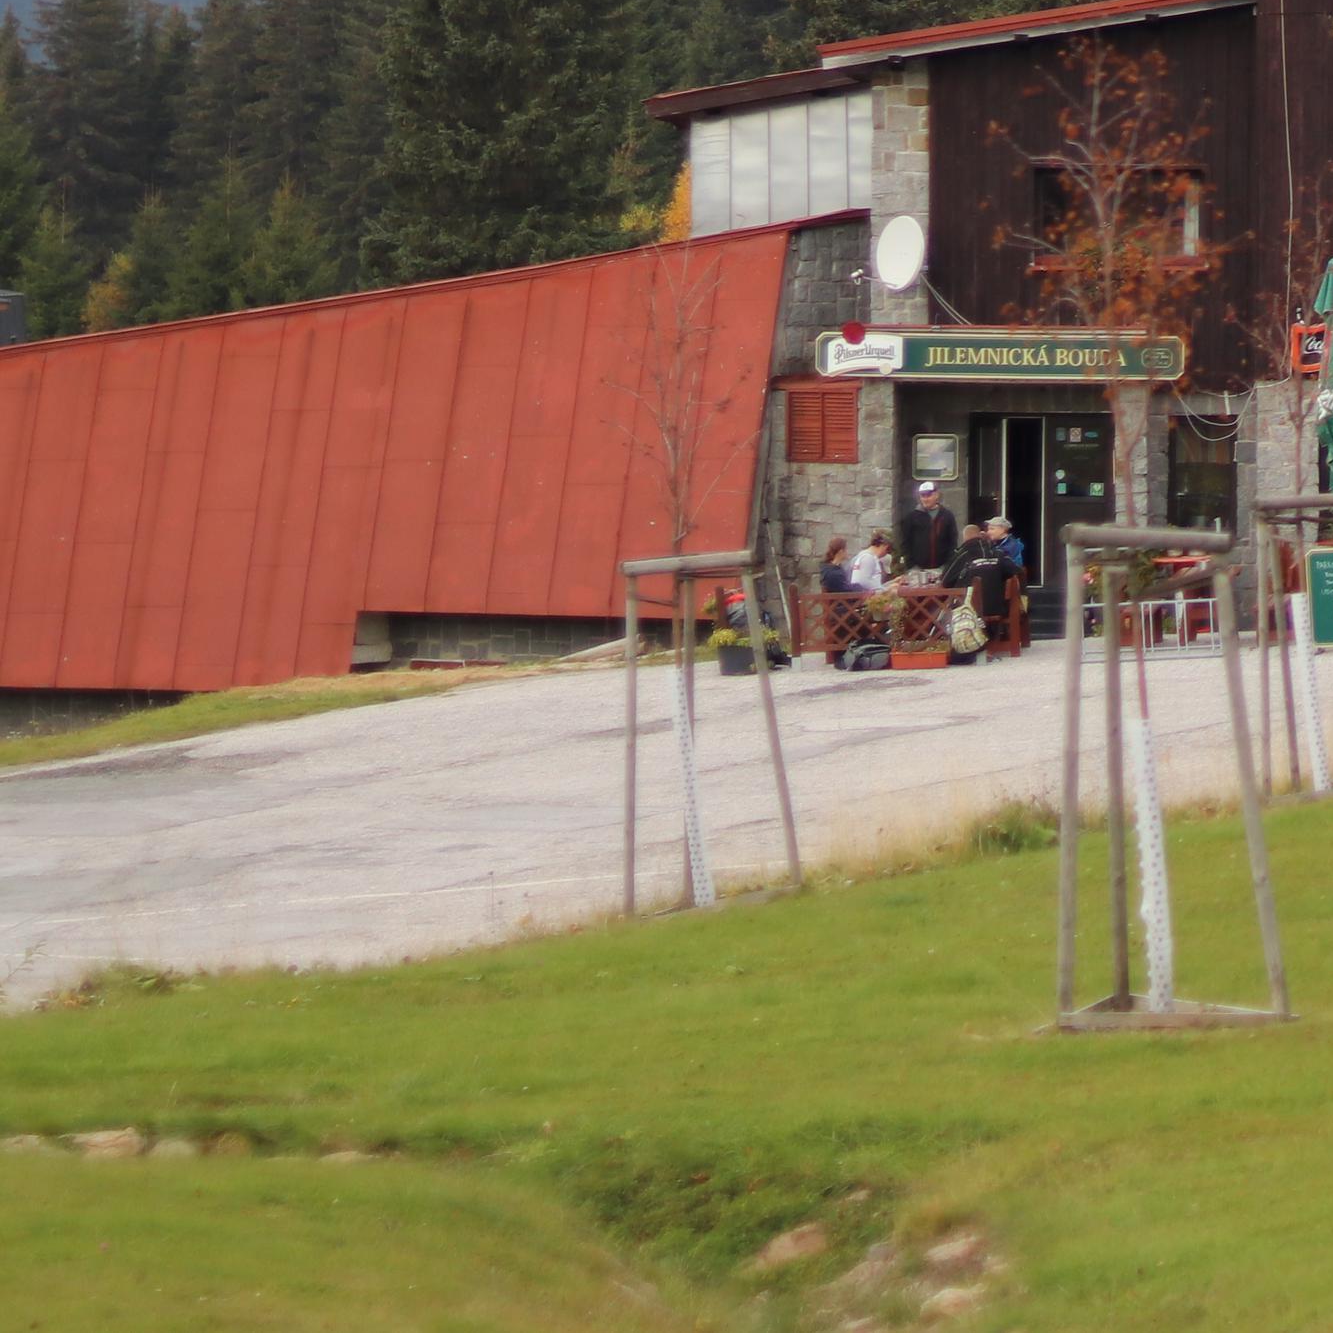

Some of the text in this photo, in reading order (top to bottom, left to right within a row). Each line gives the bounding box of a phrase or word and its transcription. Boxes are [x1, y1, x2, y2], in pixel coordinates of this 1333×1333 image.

[834, 343, 896, 364] Pilsner Urquell
[925, 345, 1050, 367] JILEMNICKÁ
[1055, 348, 1127, 367] BOUDA
